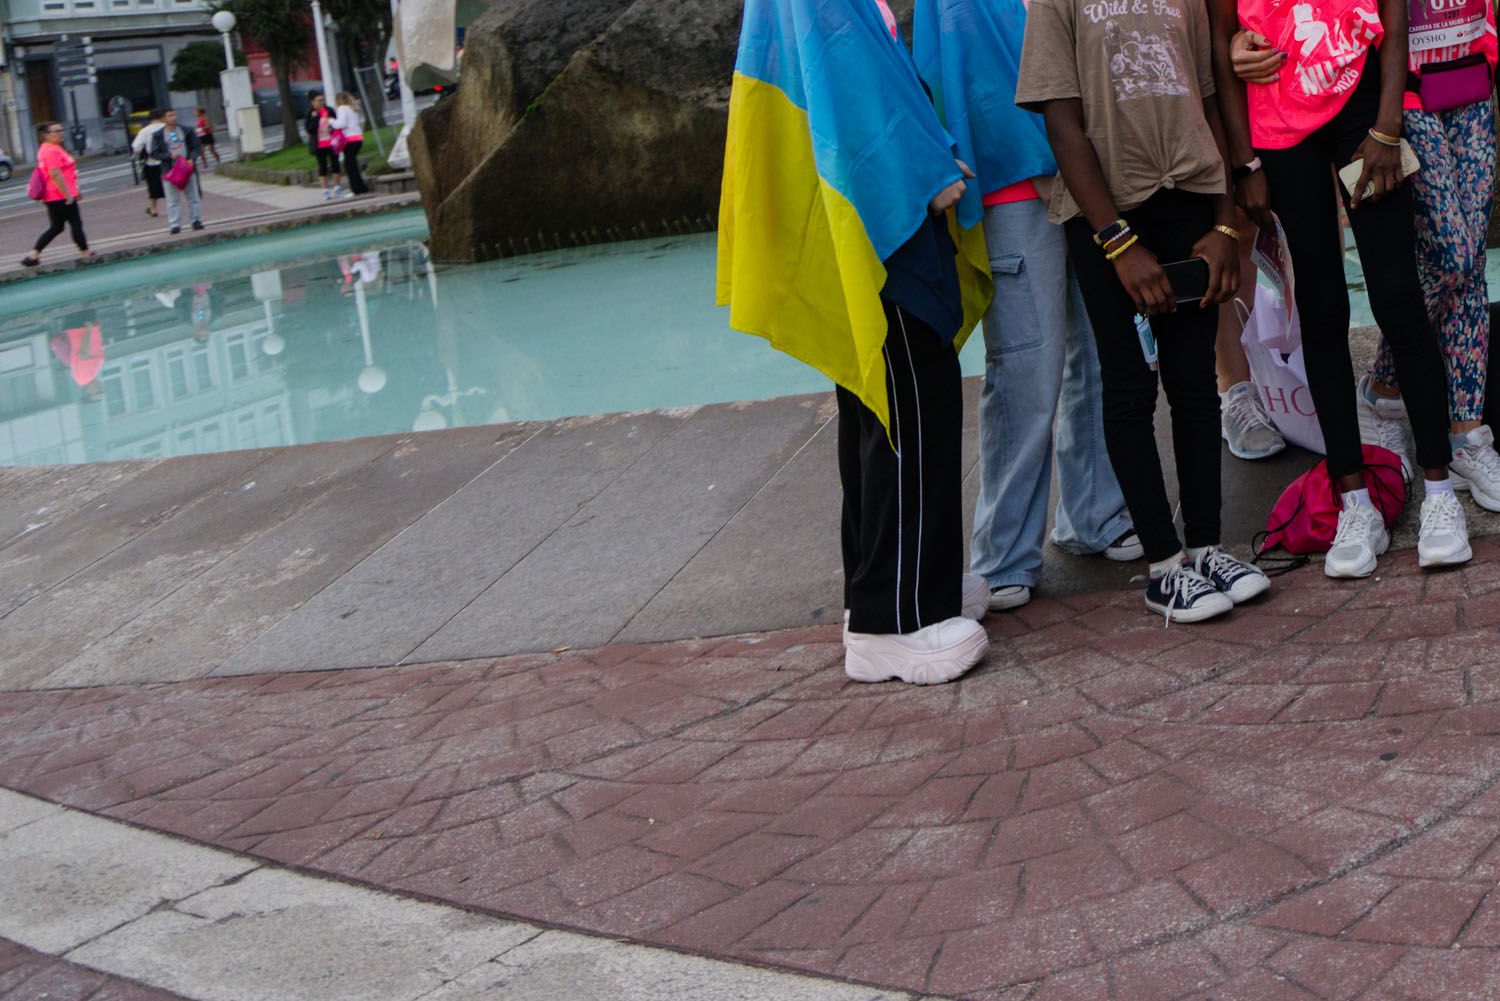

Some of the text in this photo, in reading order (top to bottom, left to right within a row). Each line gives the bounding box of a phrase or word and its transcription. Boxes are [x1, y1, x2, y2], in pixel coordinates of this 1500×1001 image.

[1084, 0, 1181, 23] Wild & Free
[1412, 34, 1446, 46] OYSHO
[1333, 67, 1359, 95] 2026
